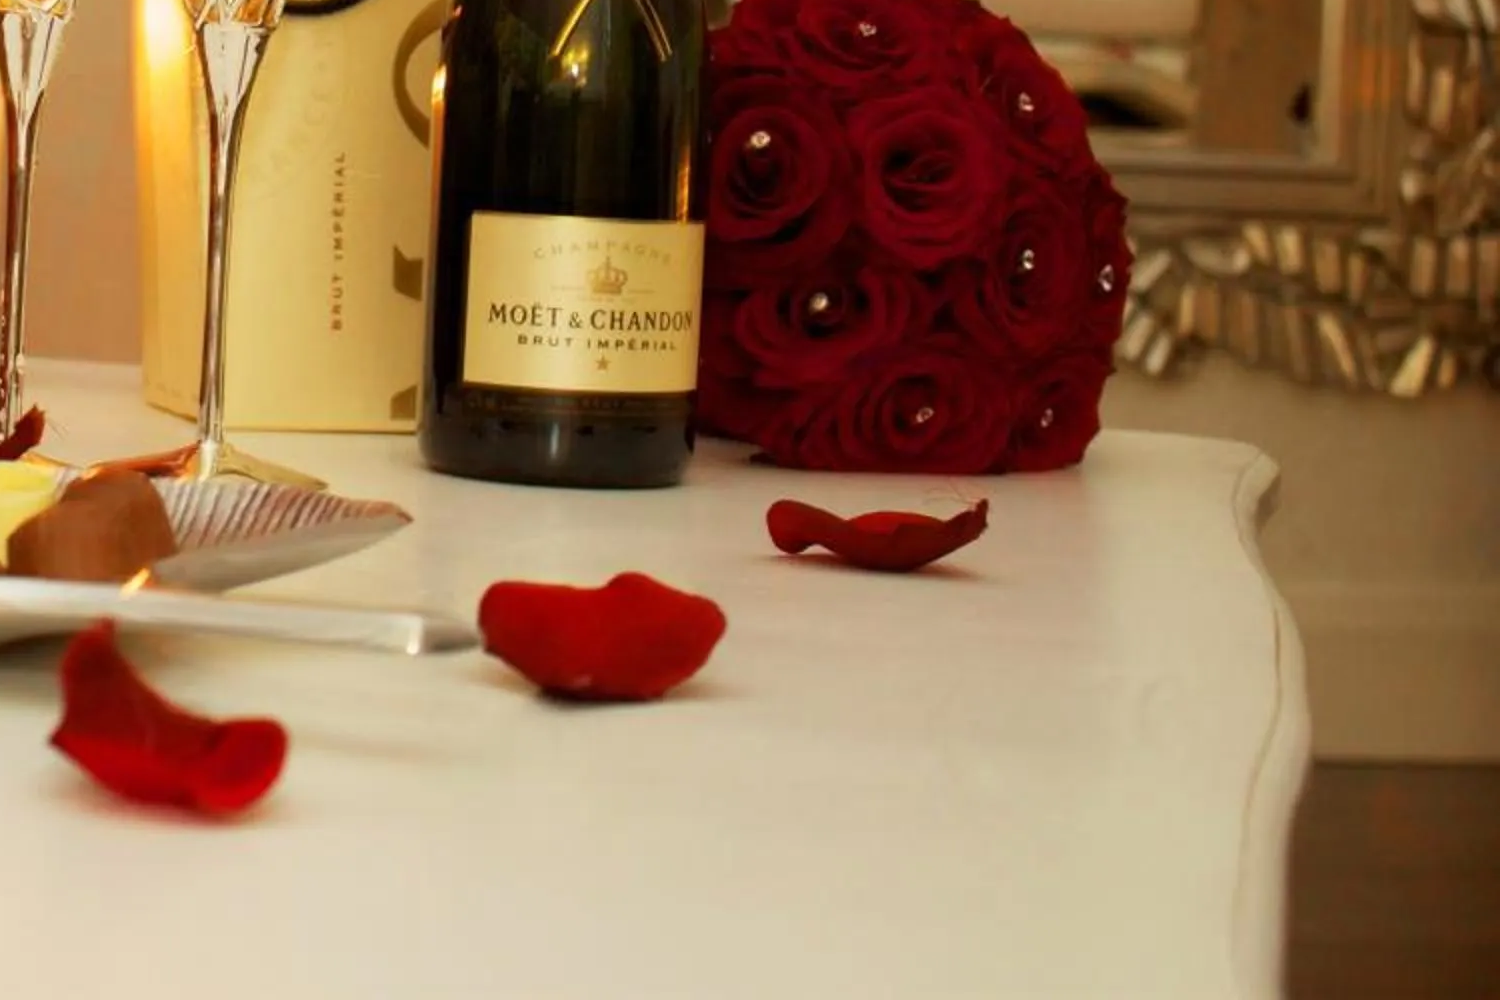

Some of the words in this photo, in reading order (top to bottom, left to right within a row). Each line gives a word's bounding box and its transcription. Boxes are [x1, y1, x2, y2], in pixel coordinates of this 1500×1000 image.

[331, 152, 345, 261] IMPÉRIAL
[331, 272, 344, 331] BRUT
[488, 300, 563, 327] MOËT
[568, 311, 584, 329] &
[590, 308, 694, 332] CHANDON
[517, 335, 574, 348] BRUT
[586, 336, 678, 352] IMPÉRIAL
